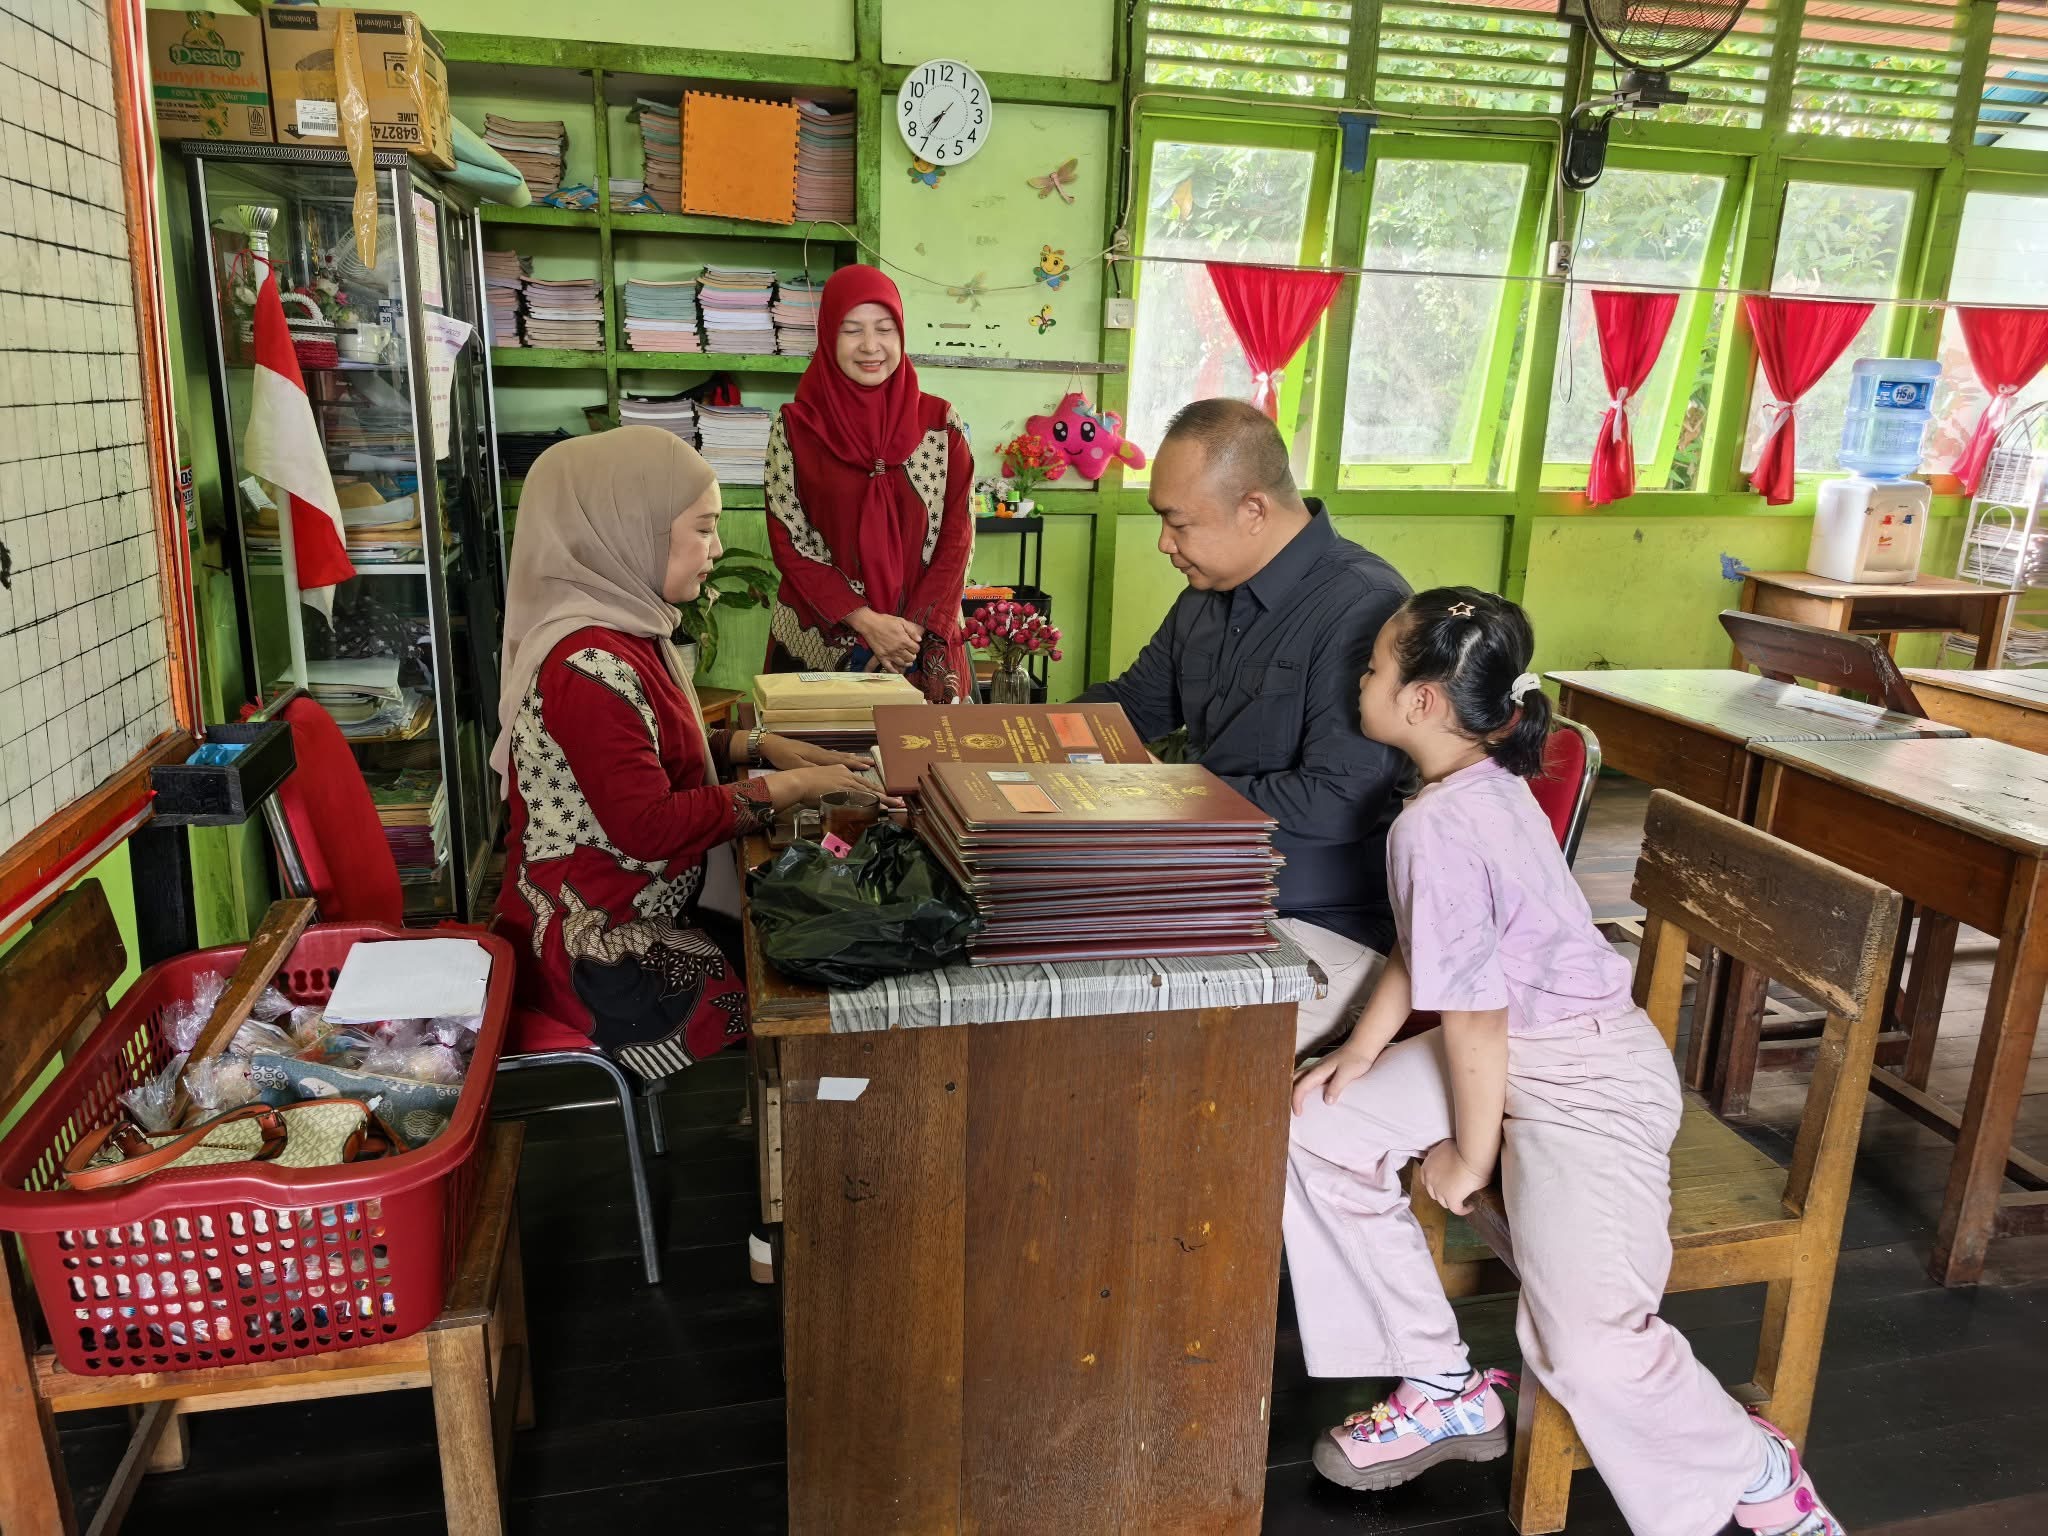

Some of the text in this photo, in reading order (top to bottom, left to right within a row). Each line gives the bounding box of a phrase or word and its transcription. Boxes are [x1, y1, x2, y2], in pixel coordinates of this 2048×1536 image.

[171, 44, 239, 71] Desaku
[209, 69, 259, 88] bubuk
[925, 68, 936, 86] 11
[940, 65, 953, 82] 12
[910, 81, 924, 98] 10
[970, 88, 980, 104] 2
[397, 112, 418, 122] LIME
[904, 101, 913, 117] 9
[973, 108, 983, 125] 3
[371, 125, 419, 141] 648274
[908, 121, 917, 137] 8
[967, 127, 977, 143] 4
[920, 136, 929, 153] 7
[936, 143, 946, 159] 6
[953, 140, 963, 156] 5
